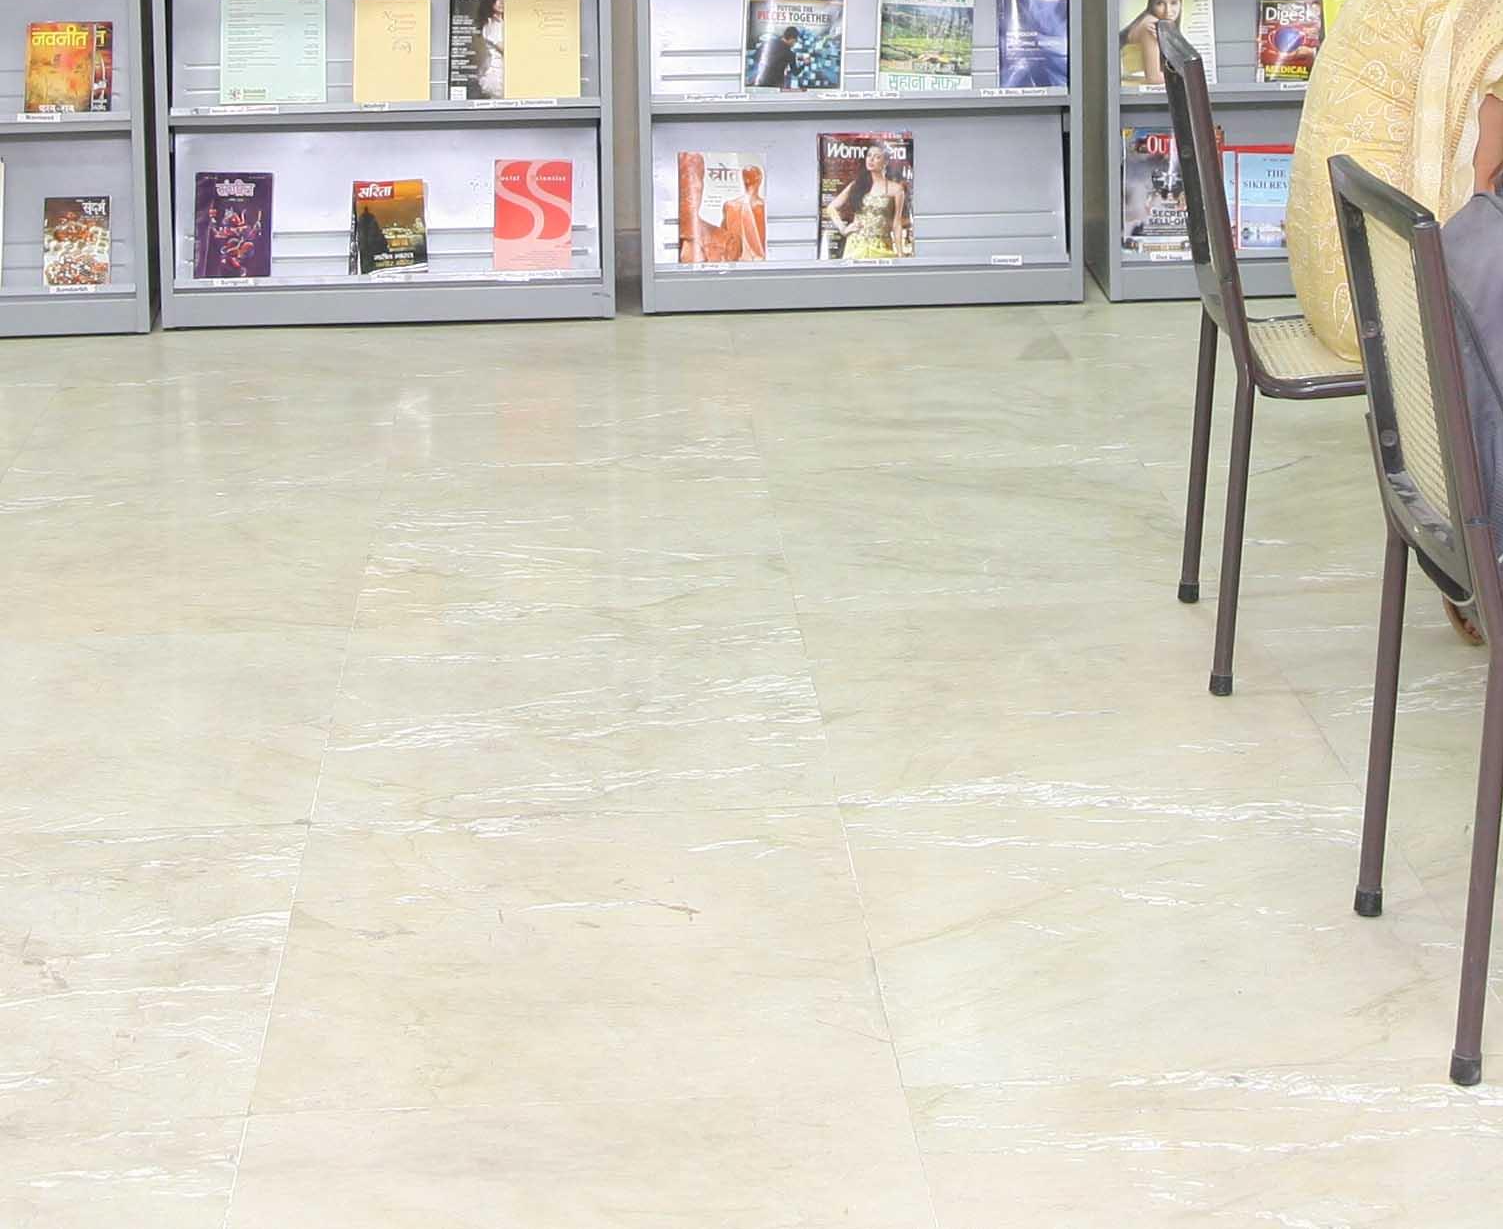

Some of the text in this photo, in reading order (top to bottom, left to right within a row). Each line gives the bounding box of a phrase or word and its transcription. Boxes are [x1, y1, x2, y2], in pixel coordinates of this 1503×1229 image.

[788, 12, 832, 23] TOGETHER
[1265, 6, 1312, 25] Digest
[31, 26, 89, 47] नवनीत
[1266, 170, 1287, 178] THE
[1242, 180, 1266, 189] SIKH
[358, 184, 393, 198] सरिता
